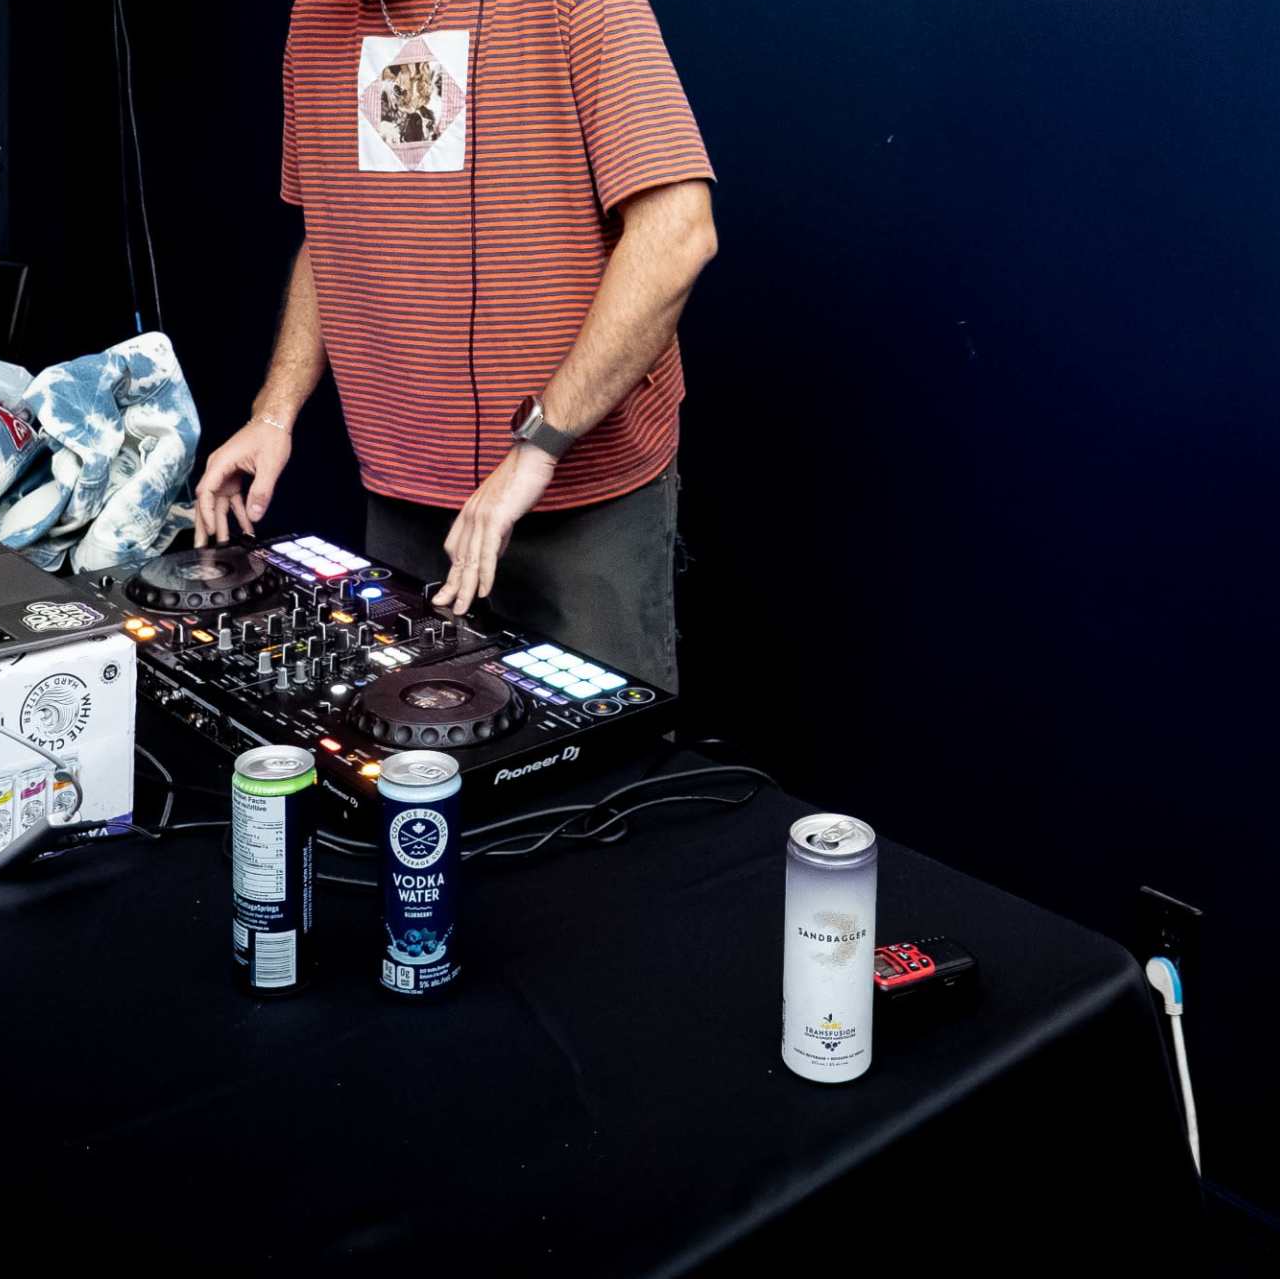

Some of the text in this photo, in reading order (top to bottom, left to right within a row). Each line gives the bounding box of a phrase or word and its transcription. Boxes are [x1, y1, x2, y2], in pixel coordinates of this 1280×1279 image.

[24, 677, 79, 724] HARD SELTZER
[27, 693, 92, 752] WHITE CLAW
[493, 754, 560, 785] Pioneer
[322, 779, 349, 801] Pioneer
[391, 810, 447, 839] COTTAGE SPRINGS
[396, 850, 429, 866] BEVERAGE
[393, 872, 445, 889] VODKA
[398, 887, 440, 903] WATER
[797, 926, 867, 943] SANDBAGGER
[805, 1025, 856, 1037] TRANSFUSION
